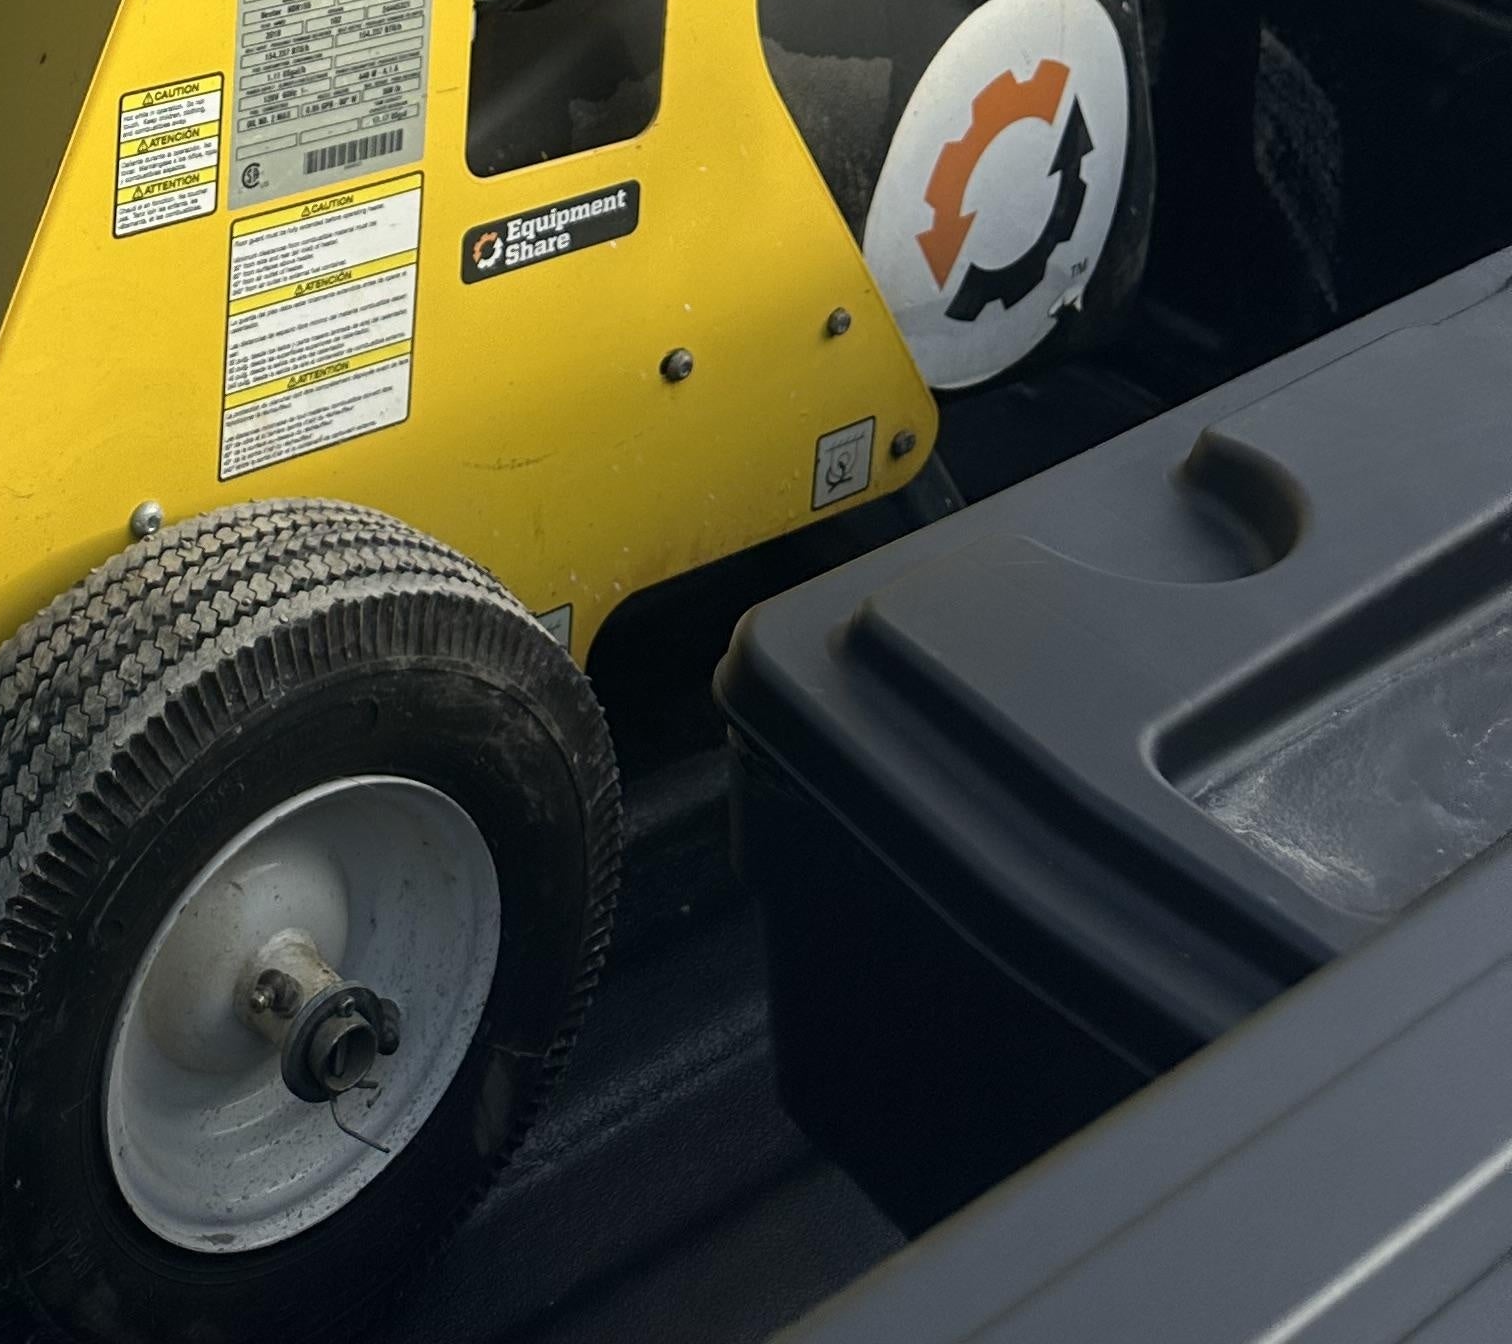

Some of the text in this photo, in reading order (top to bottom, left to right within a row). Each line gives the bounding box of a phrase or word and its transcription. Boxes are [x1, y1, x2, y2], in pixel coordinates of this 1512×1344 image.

[154, 82, 200, 101] CAUTION
[144, 173, 200, 194] ATTENTION
[311, 194, 355, 213] CAUTION
[505, 188, 627, 242] Equipment
[504, 231, 572, 266] Share
